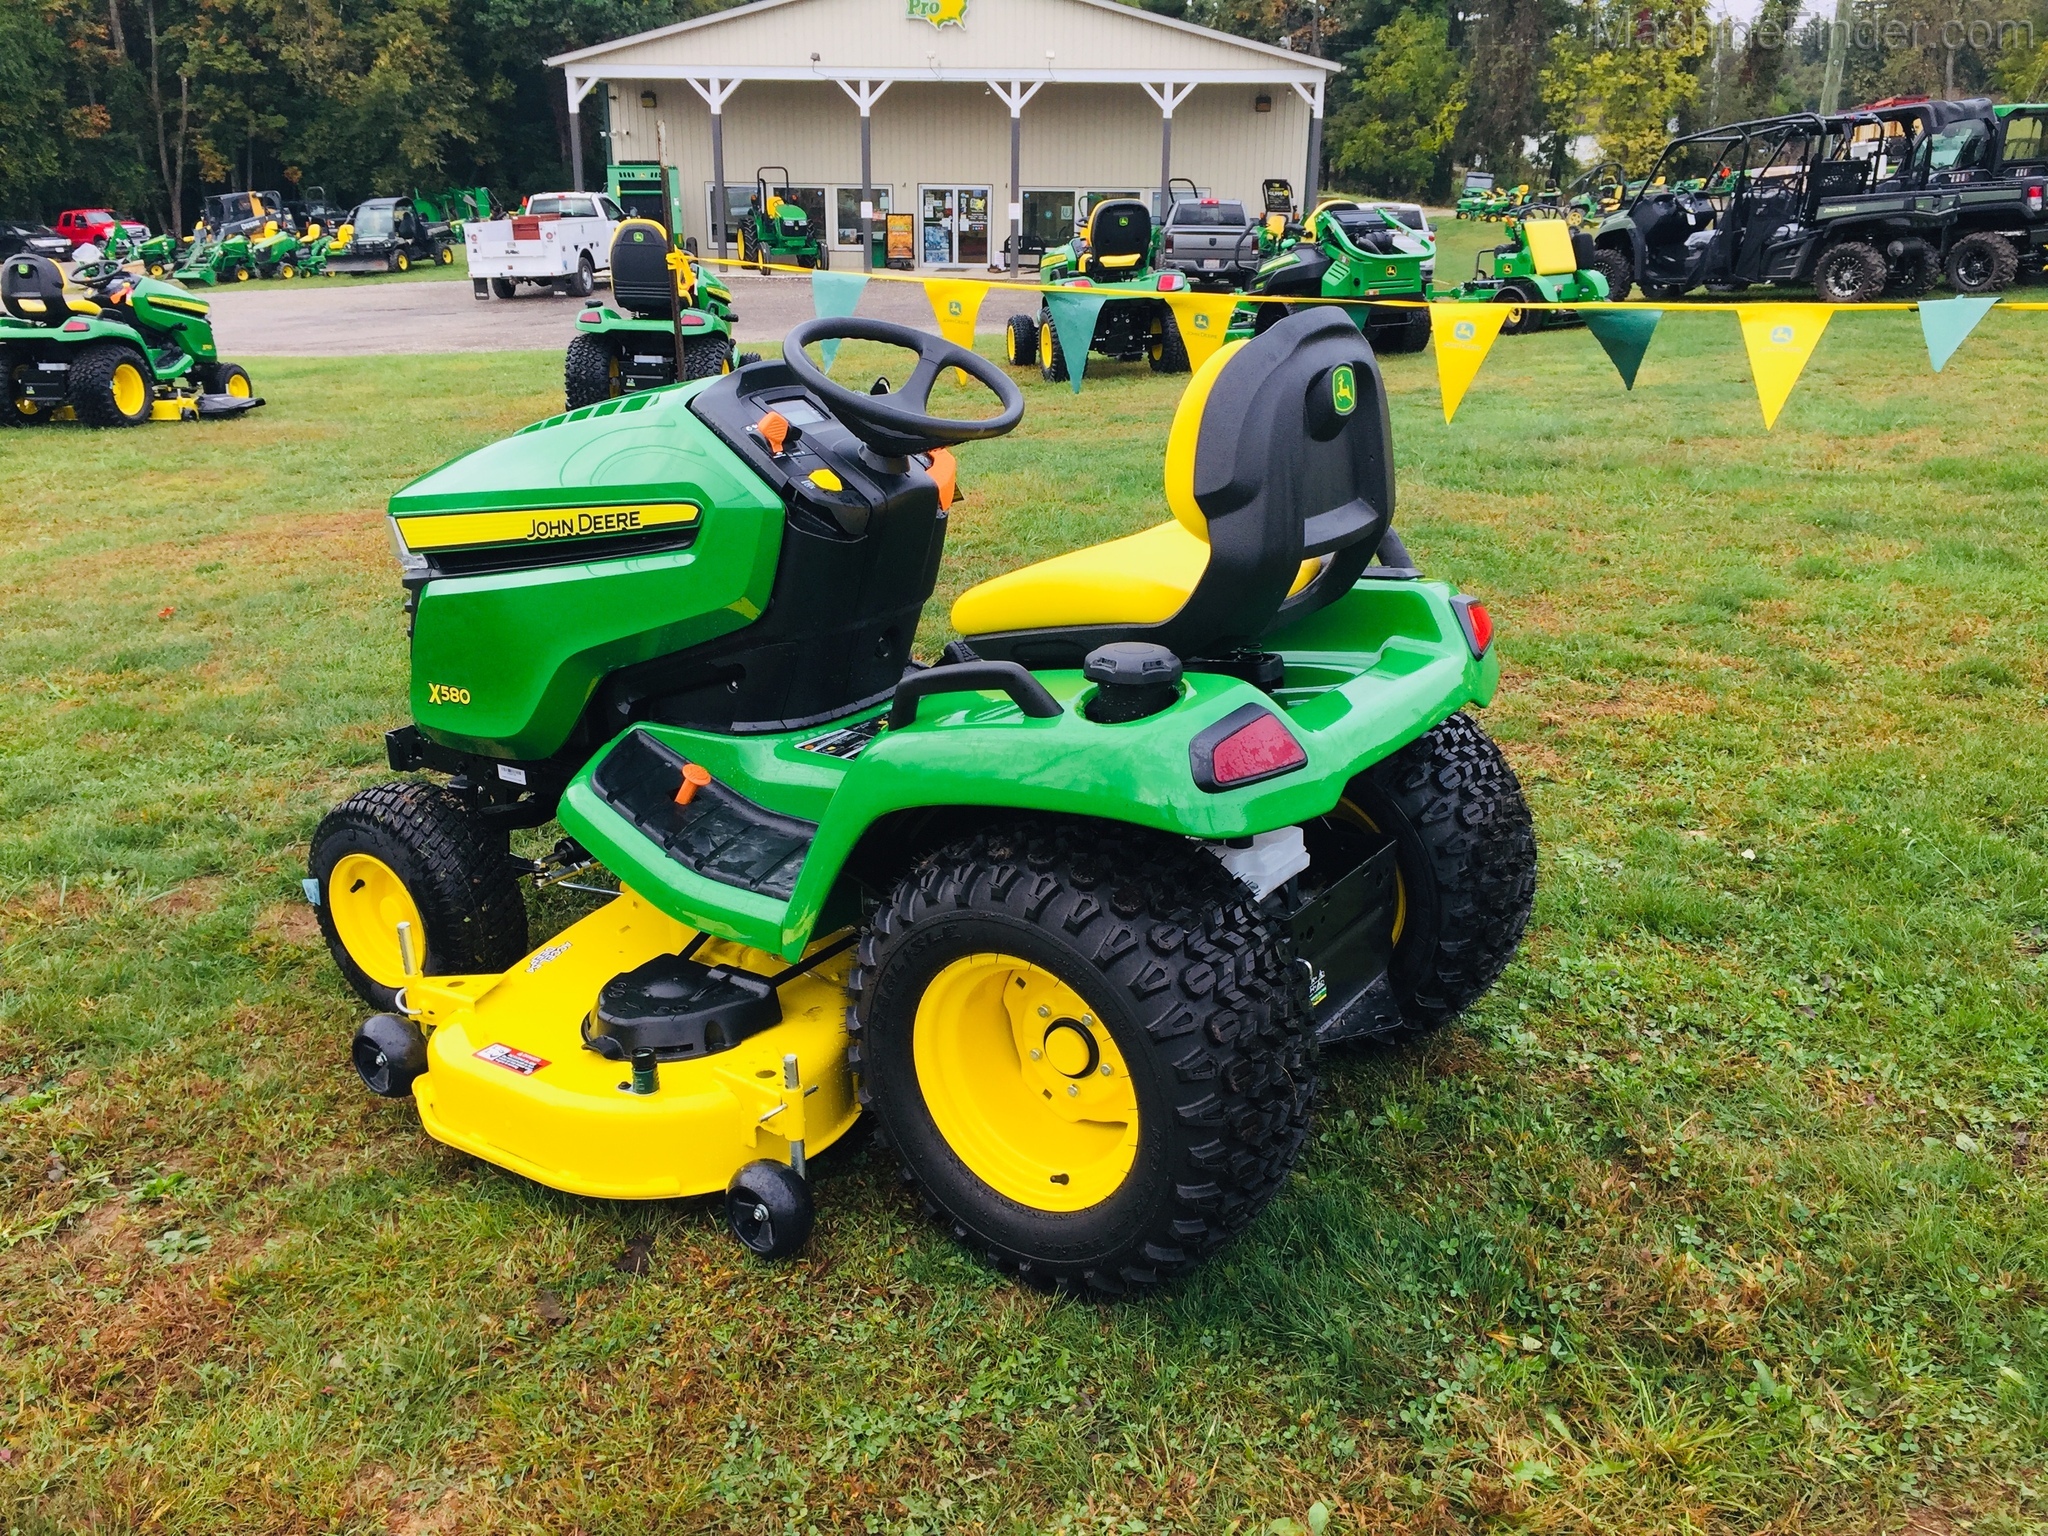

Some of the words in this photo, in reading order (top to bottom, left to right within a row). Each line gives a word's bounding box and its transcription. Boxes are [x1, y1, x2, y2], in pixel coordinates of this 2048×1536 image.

[907, 0, 941, 15] Pro
[527, 519, 574, 538] JOHN
[578, 511, 641, 532] DEERE
[428, 682, 471, 705] X580
